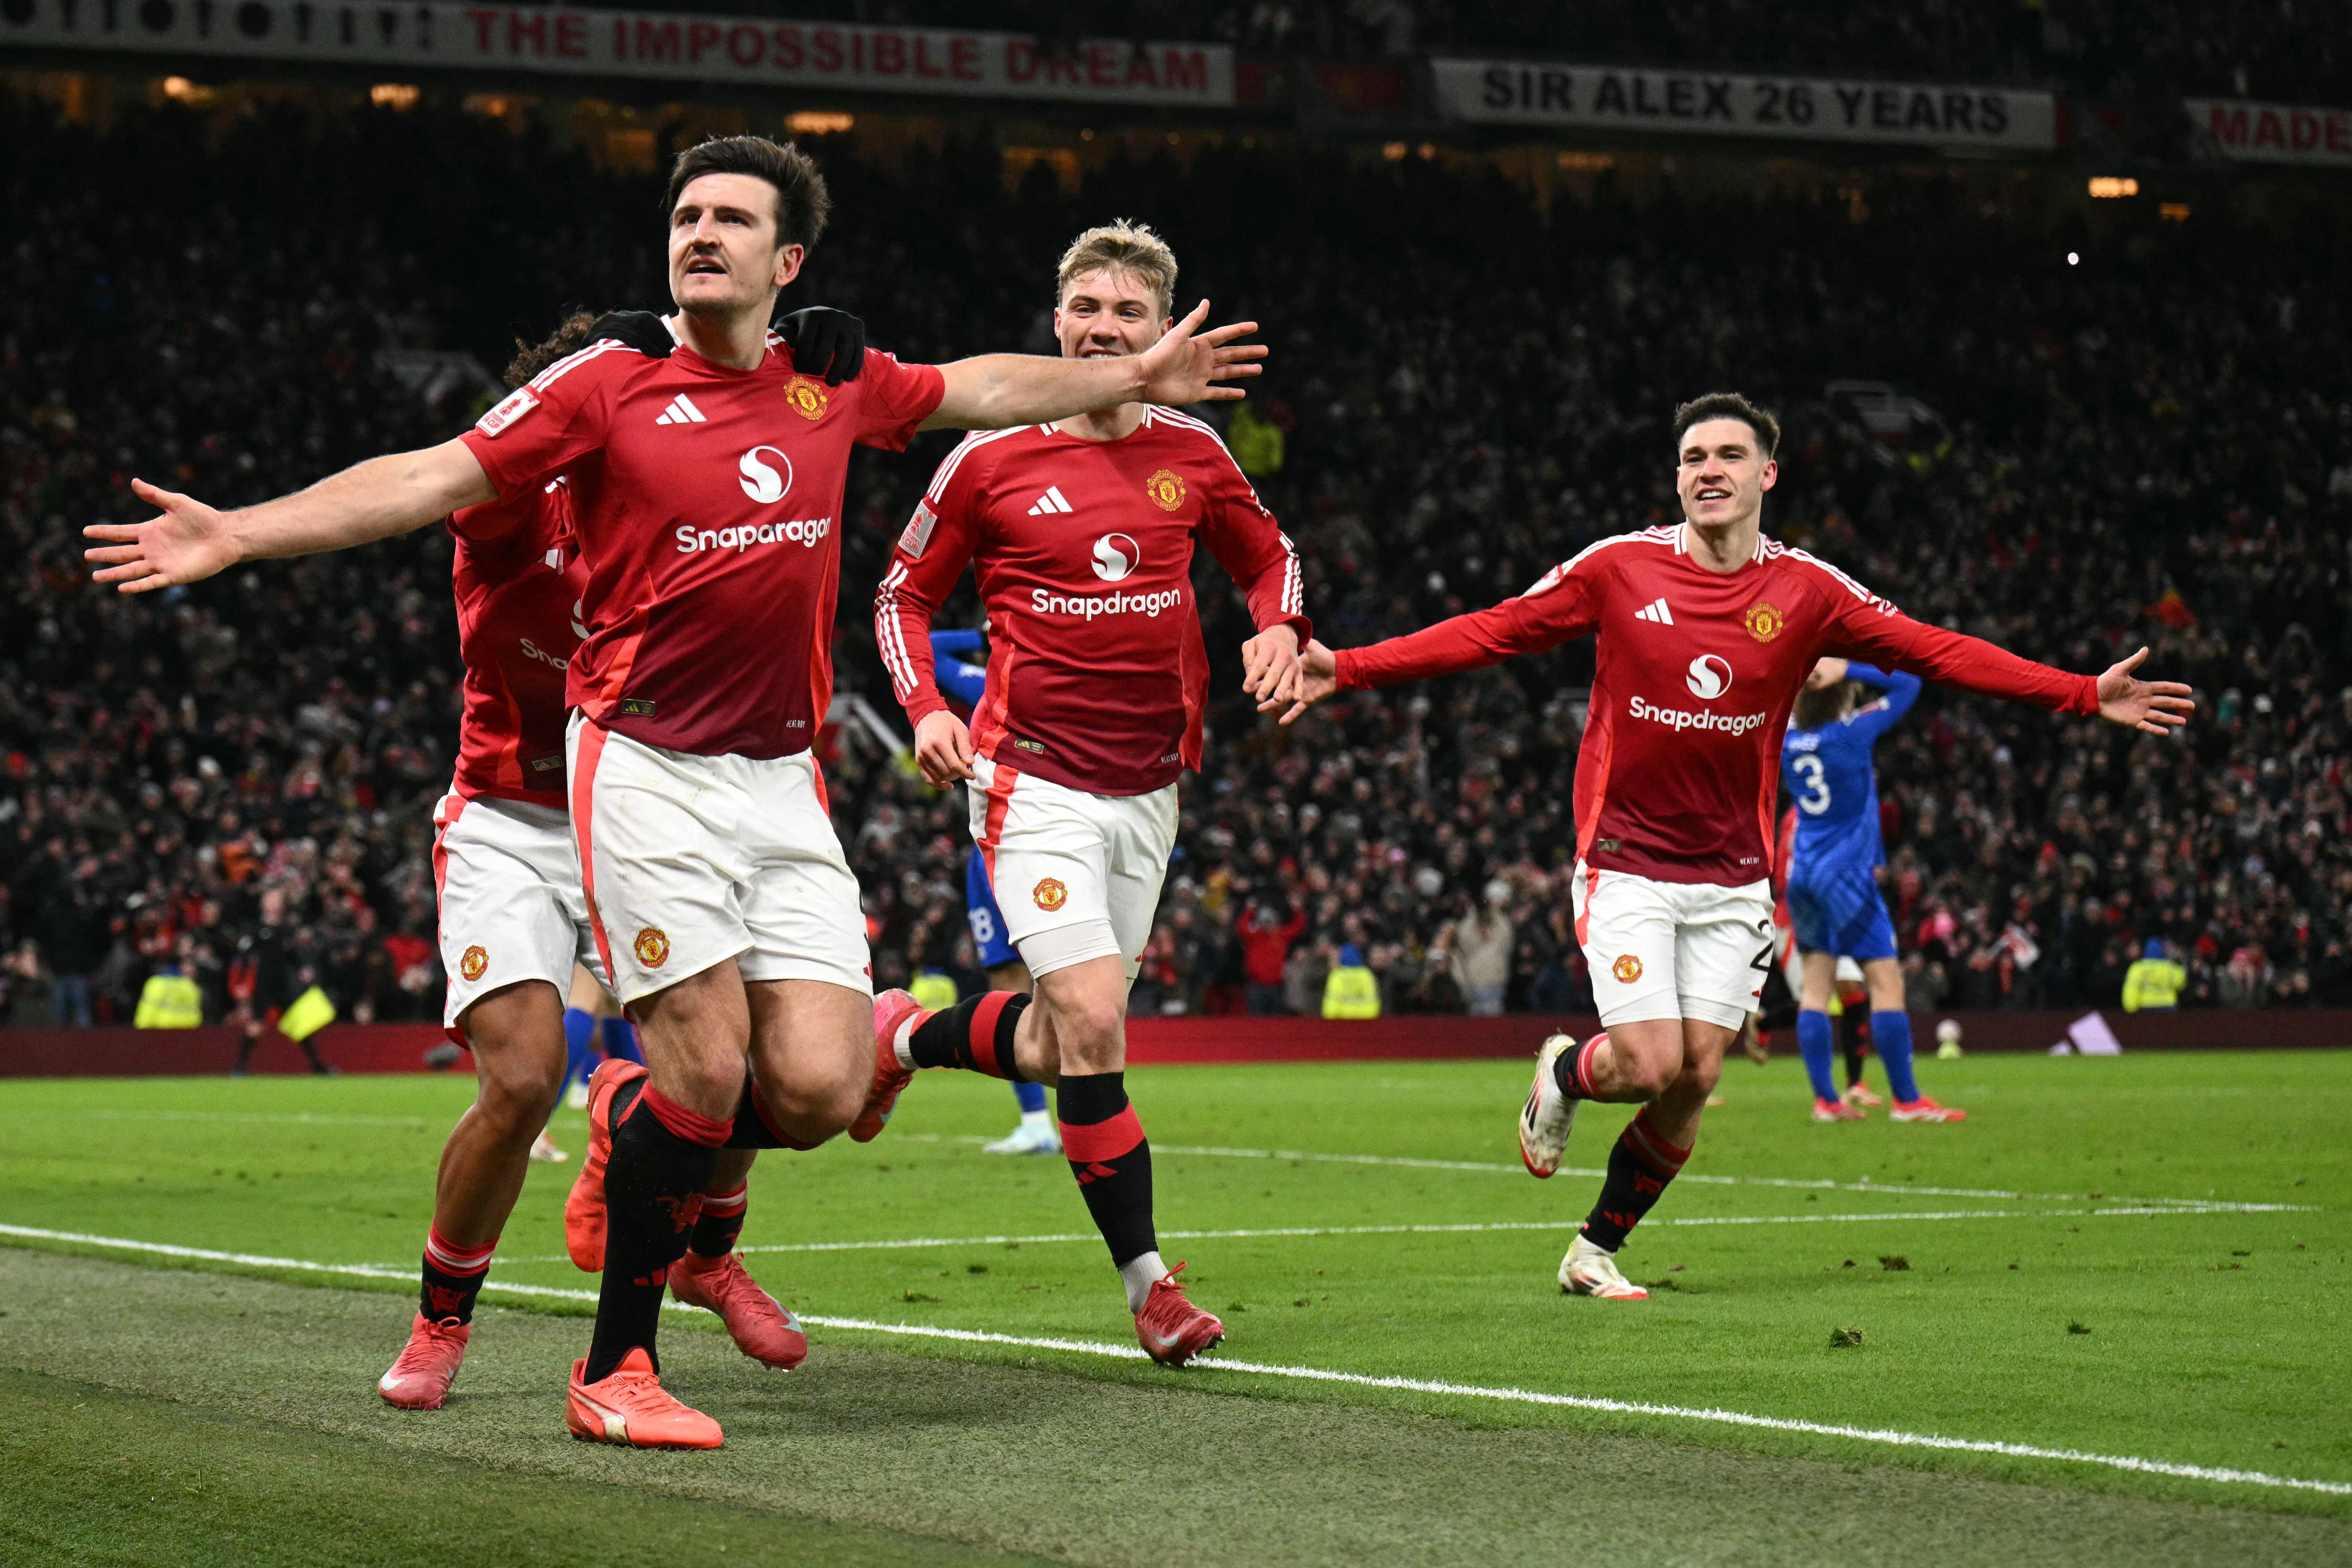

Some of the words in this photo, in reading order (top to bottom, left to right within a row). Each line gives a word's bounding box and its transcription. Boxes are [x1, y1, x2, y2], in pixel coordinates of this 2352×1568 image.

[467, 10, 587, 58] THE
[614, 18, 981, 81] IMPOSSIBLE
[1005, 40, 1208, 90] DREAM
[1483, 68, 1571, 111] SIR
[1595, 76, 1731, 121] ALEX
[1755, 83, 1815, 125] 26
[1835, 88, 2008, 135] YEARS
[2211, 107, 2352, 152] MADE
[787, 380, 819, 394] MANCHESTER
[801, 409, 823, 417] UNITED
[487, 419, 500, 428] CUP
[1150, 472, 1181, 487] MANCHESTER
[1159, 500, 1180, 509] UNITED
[905, 538, 919, 550] CUP
[1031, 588, 1181, 621] Snapdragon
[1629, 695, 1766, 736] Snapdragon
[1792, 754, 1832, 816] 3
[1035, 880, 1062, 894] MANCHESTER
[1043, 901, 1062, 910] UNITED
[648, 954, 666, 966] UNITED
